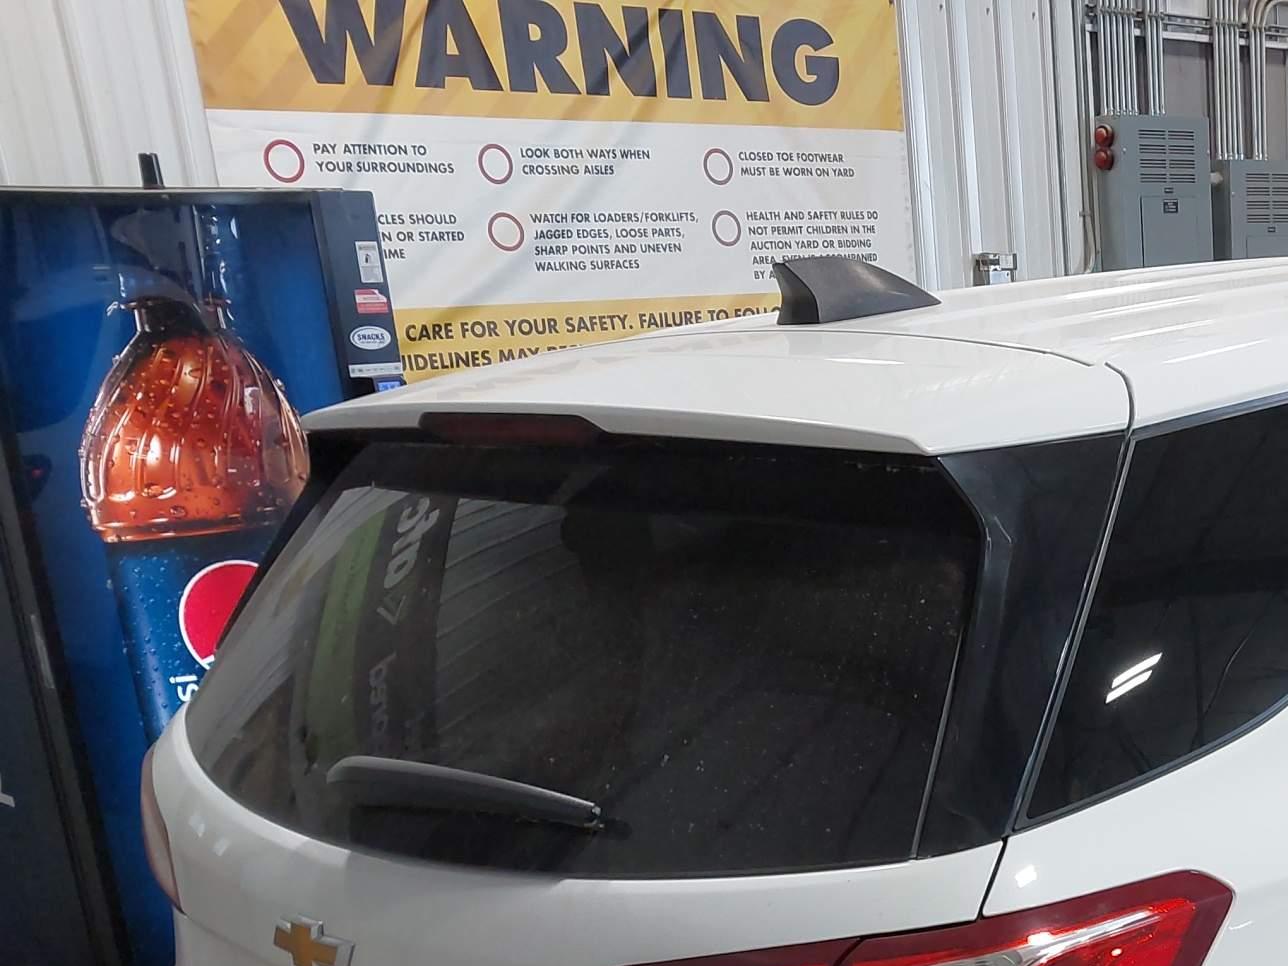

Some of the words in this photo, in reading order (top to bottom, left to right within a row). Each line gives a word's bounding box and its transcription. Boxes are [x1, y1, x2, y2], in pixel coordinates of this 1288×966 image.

[278, 0, 840, 106] WARNING
[313, 143, 337, 155] PAY
[343, 143, 408, 156] ATTENTION
[411, 145, 427, 156] TO
[520, 147, 550, 159] LOOK
[553, 148, 584, 160] BOTH
[587, 149, 617, 160] WAYS
[619, 149, 650, 160] WHEN
[738, 151, 774, 162] CLOSED
[776, 152, 794, 162] TOE
[796, 152, 844, 163] FOOTWEAR
[316, 161, 353, 173] YOUR
[356, 161, 455, 174] SURROUNDINGS
[522, 164, 580, 176] CROSSING
[583, 164, 615, 176] AISLES
[740, 167, 766, 177] MUST
[769, 167, 780, 177] BE
[782, 167, 813, 177] WORN
[815, 168, 830, 177] ON
[832, 168, 855, 178] YARD
[408, 214, 457, 225] SHOULD
[530, 213, 568, 224] WATCH
[571, 213, 591, 224] FOR
[593, 212, 699, 224] LOADERS/FORKLIFTS,
[746, 211, 781, 221] HEALTH
[784, 211, 805, 220] AND
[807, 211, 837, 220] SAFETY
[840, 211, 865, 220] RULES
[866, 210, 879, 220] DO
[396, 231, 415, 242] OR
[418, 231, 465, 242] STARTED
[534, 228, 573, 240] JAGGED
[576, 228, 613, 240] EDGES,
[615, 228, 649, 239] LOOSE
[652, 227, 685, 238] PARTS,
[748, 226, 768, 236] NOT
[771, 226, 803, 235] PERMIT
[806, 225, 848, 235] CHILDREN
[850, 225, 860, 234] IN
[862, 225, 876, 234] THE
[534, 244, 568, 256] SHARP
[572, 244, 610, 255] POINTS
[614, 243, 637, 254] AND
[640, 242, 682, 253] UNEVEN
[750, 240, 792, 250] AUCTION
[794, 240, 819, 249] YARD
[822, 240, 835, 249] OR
[837, 239, 872, 249] BIDDING
[535, 260, 587, 272] WALKING
[590, 259, 640, 271] SURFACES
[753, 270, 766, 280] BY
[405, 322, 455, 342] CARE
[460, 320, 500, 339] FOR
[504, 318, 560, 337] YOUR
[564, 314, 633, 333] SAFETY.
[638, 310, 702, 329] FAILURE
